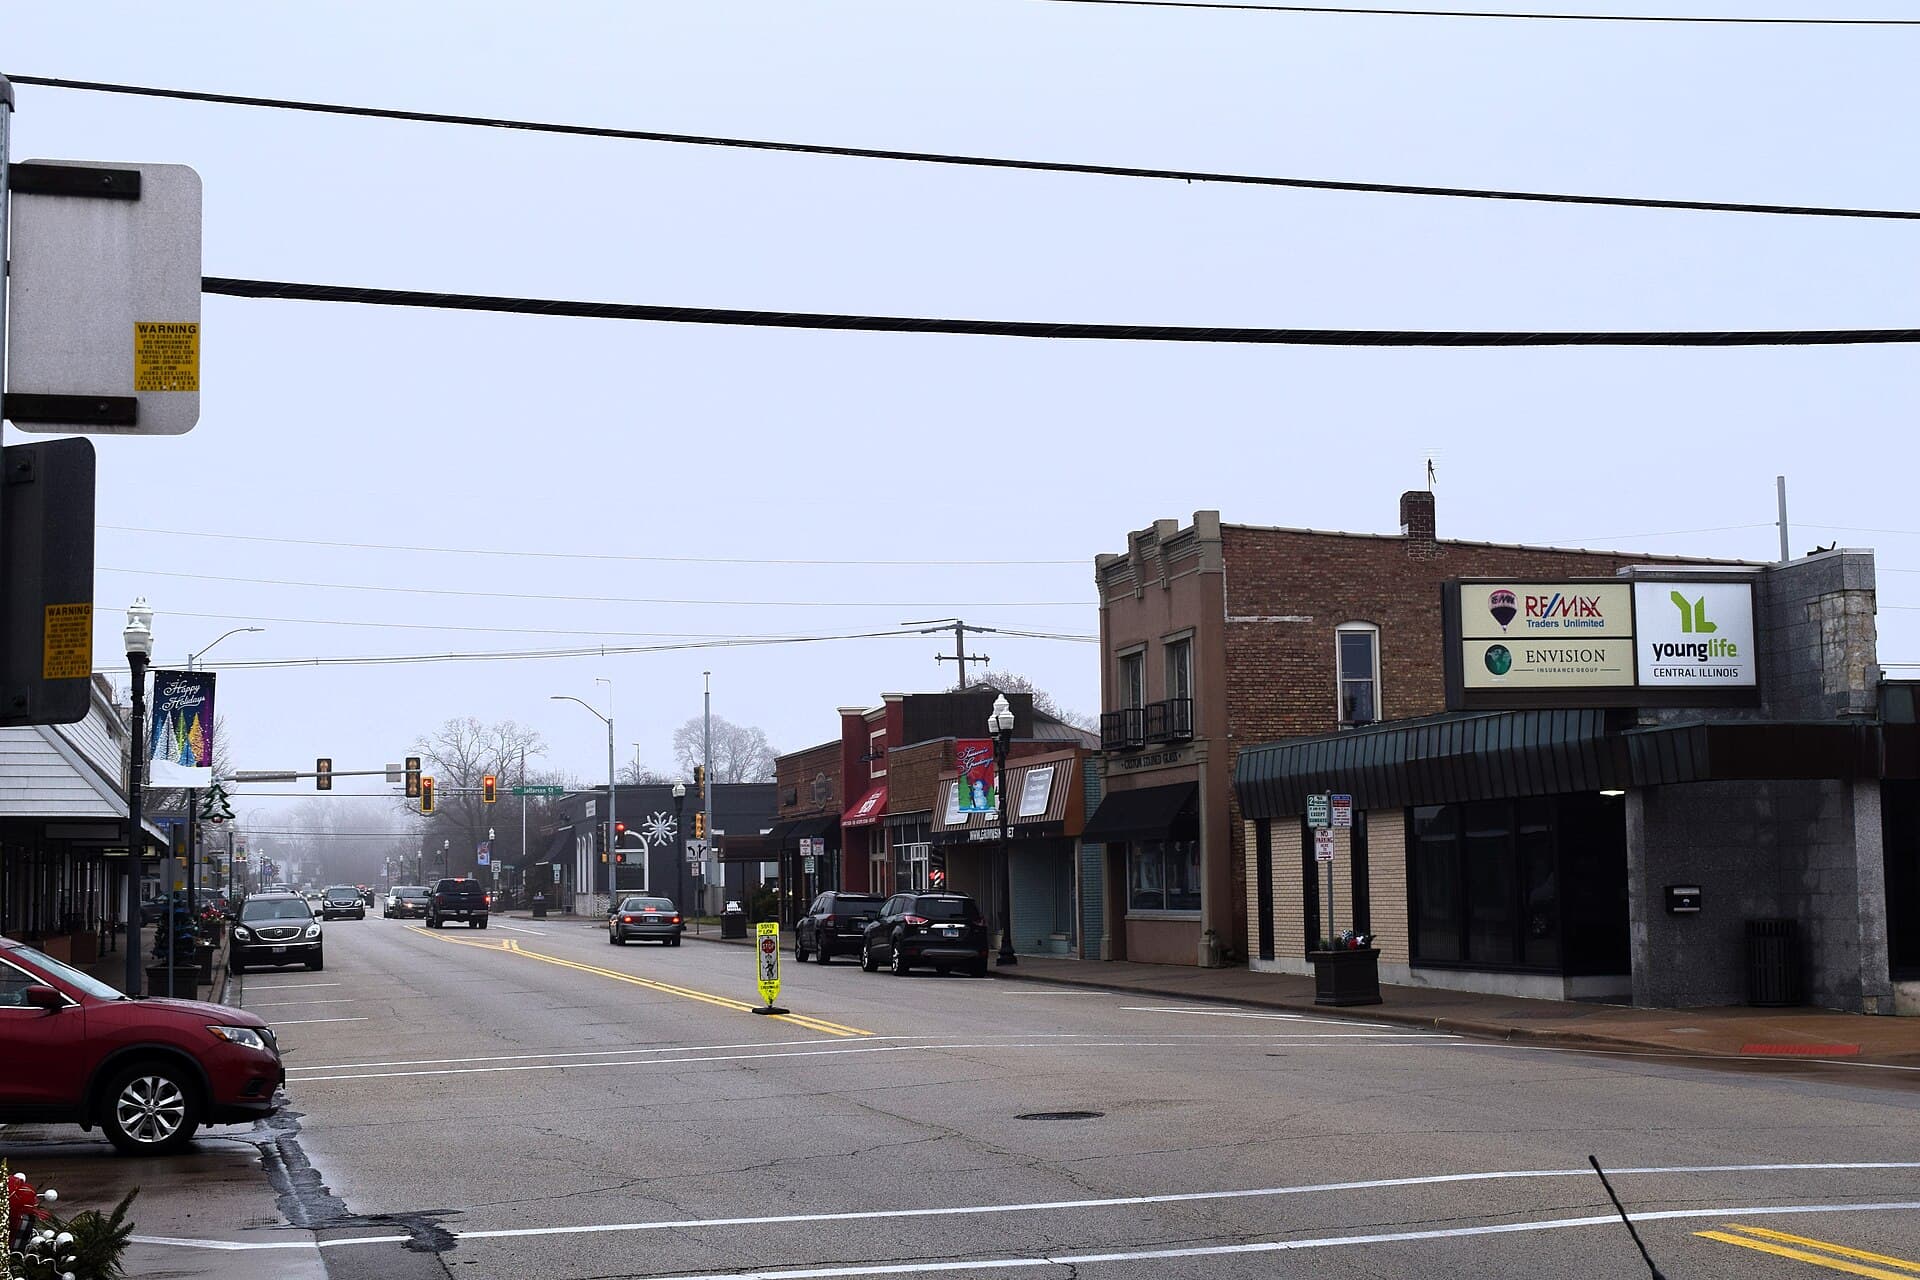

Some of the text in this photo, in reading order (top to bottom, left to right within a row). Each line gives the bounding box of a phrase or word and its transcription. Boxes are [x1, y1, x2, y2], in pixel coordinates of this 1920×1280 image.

[138, 324, 197, 334] WARNING
[48, 605, 90, 616] WARNING
[1526, 593, 1602, 618] RE/MAX
[1526, 619, 1605, 628] Traders Unlimited
[1526, 649, 1605, 663] ENVISION
[1653, 668, 1738, 677] CENTRAL ILLINOIS
[163, 680, 200, 697] Happy
[161, 695, 205, 711] Holidays
[1308, 796, 1314, 805] 2
